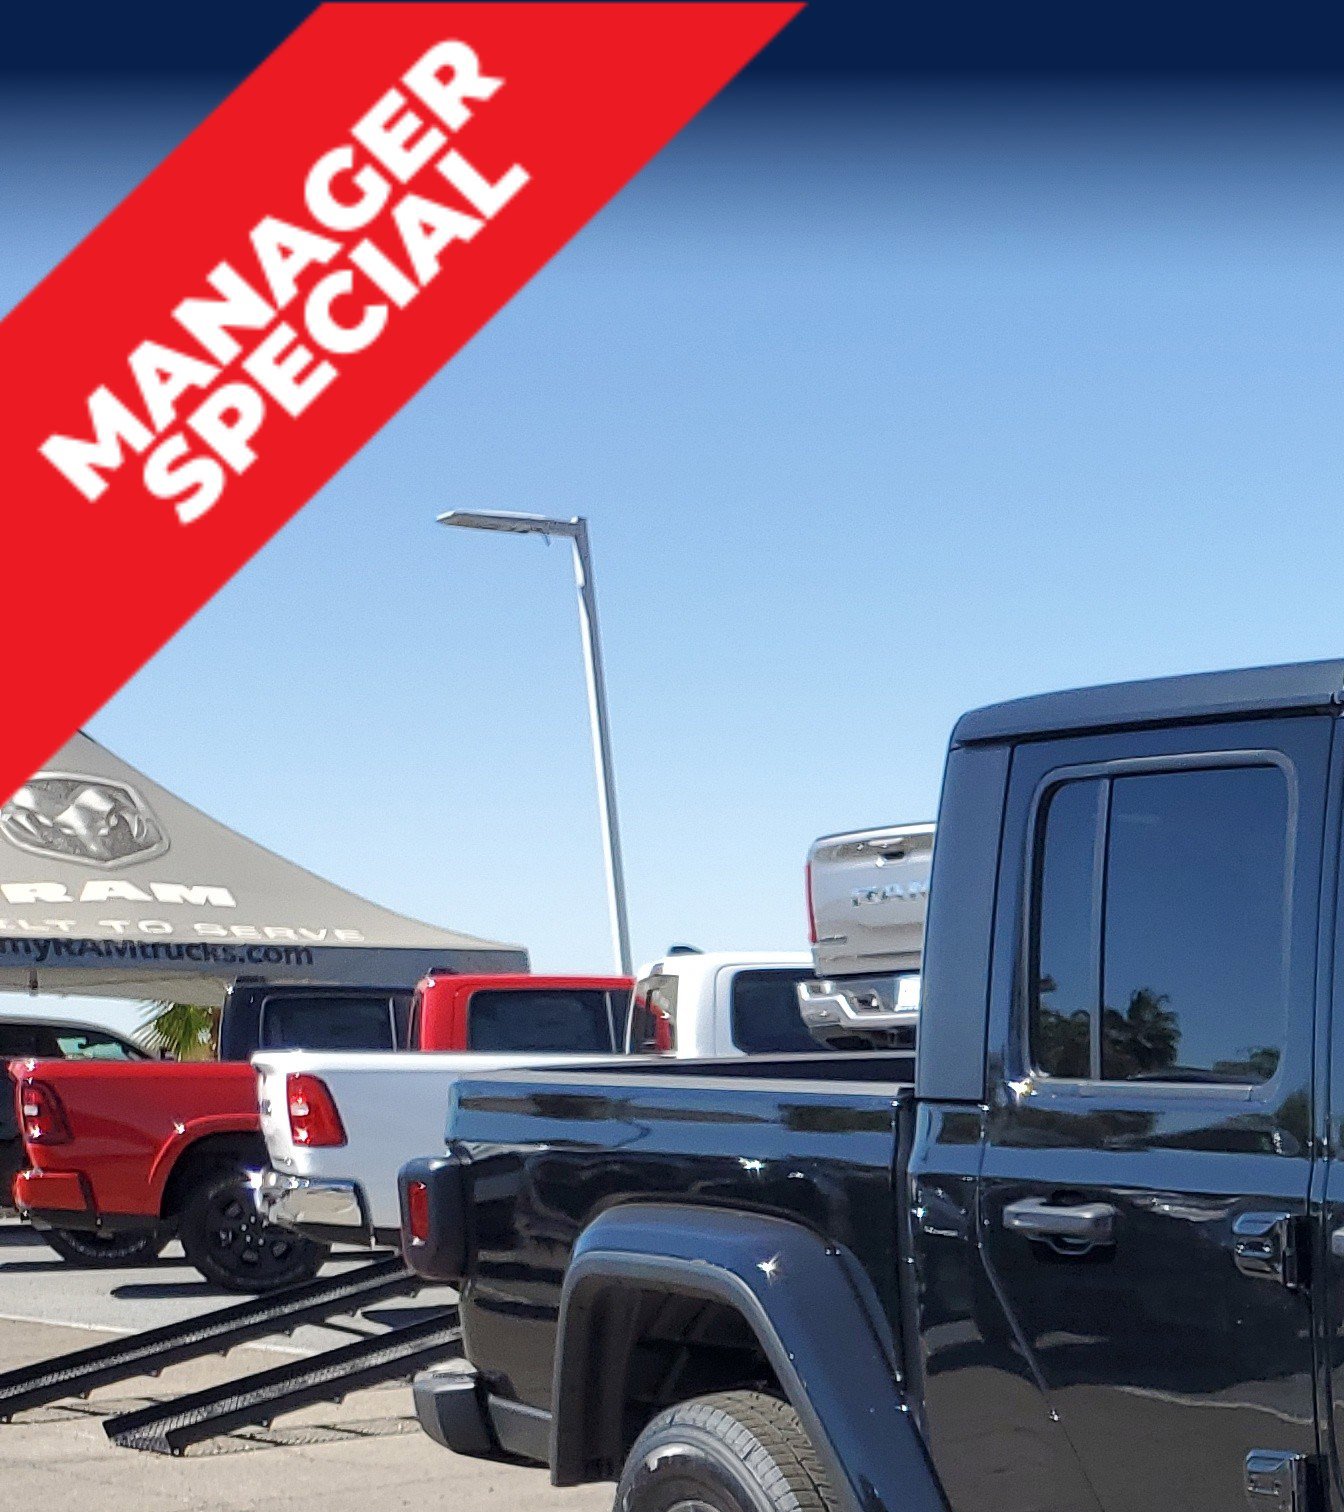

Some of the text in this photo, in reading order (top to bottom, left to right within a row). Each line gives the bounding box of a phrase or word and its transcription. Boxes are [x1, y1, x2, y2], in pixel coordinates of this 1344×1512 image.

[0, 880, 236, 908] RAM
[98, 919, 174, 936] TO
[193, 920, 365, 942] SERVE
